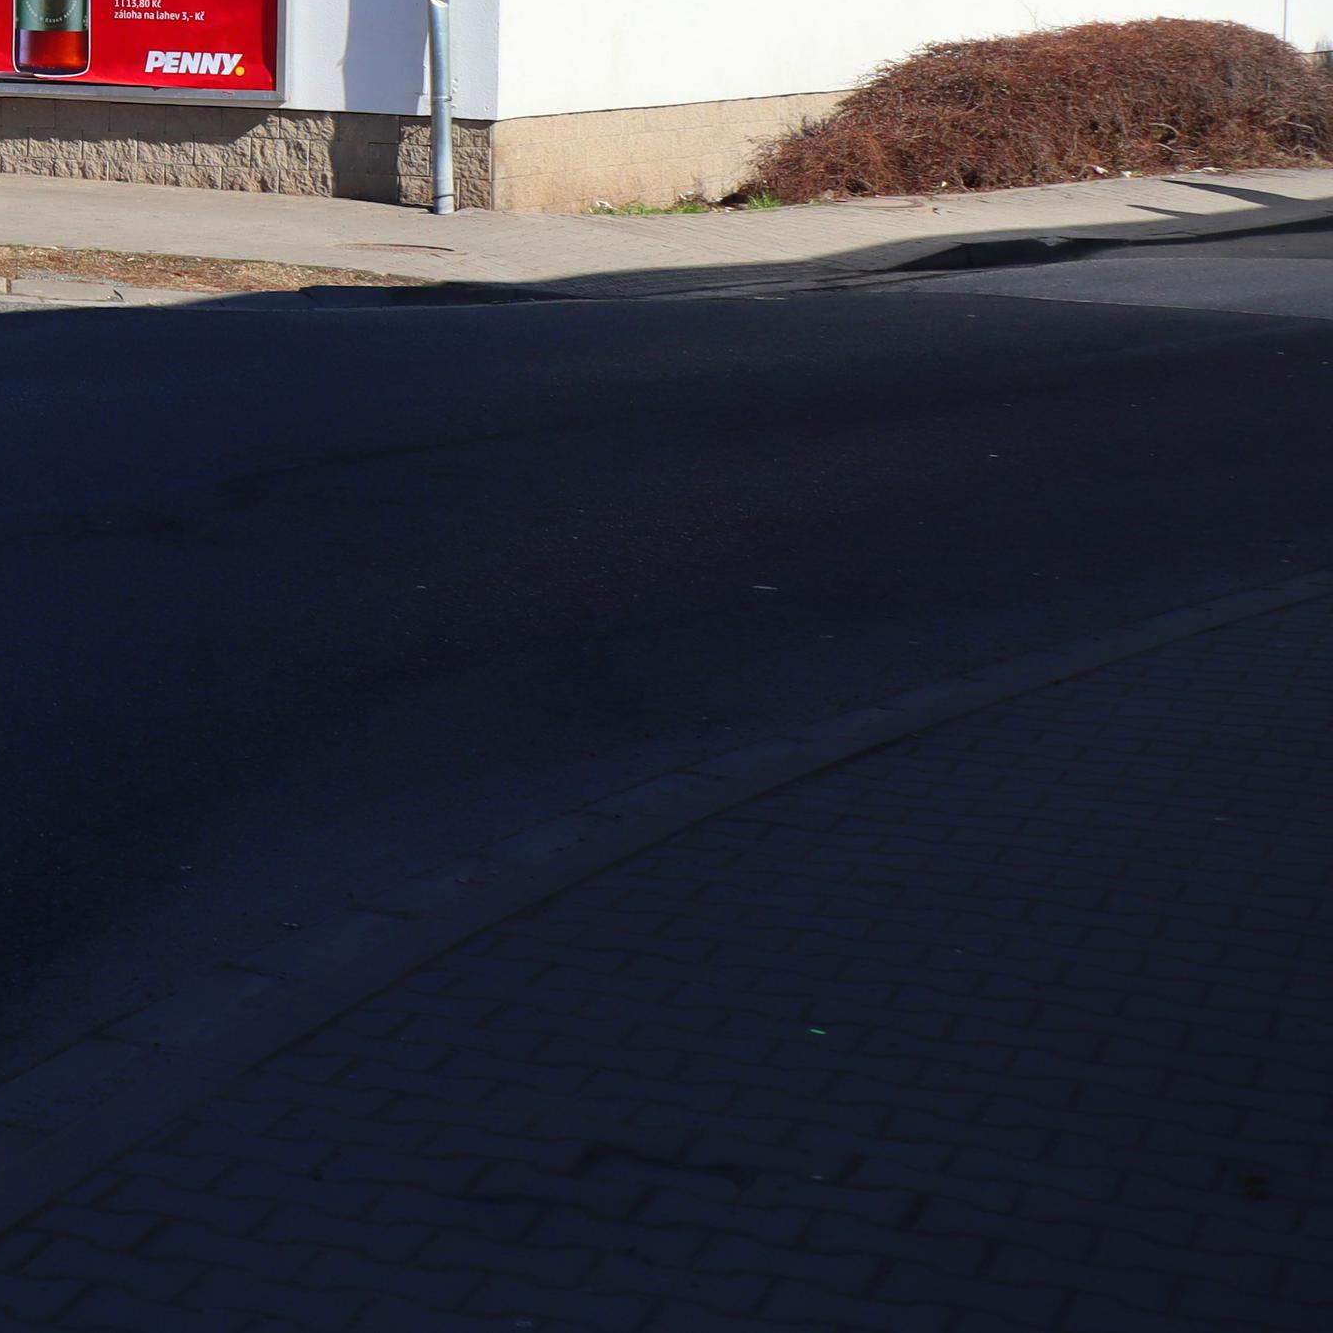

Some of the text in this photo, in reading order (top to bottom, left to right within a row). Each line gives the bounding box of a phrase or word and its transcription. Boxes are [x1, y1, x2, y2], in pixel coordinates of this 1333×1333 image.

[114, 9, 142, 20] záloha
[143, 12, 155, 20] na
[156, 11, 181, 20] lahev
[194, 11, 205, 21] Kč
